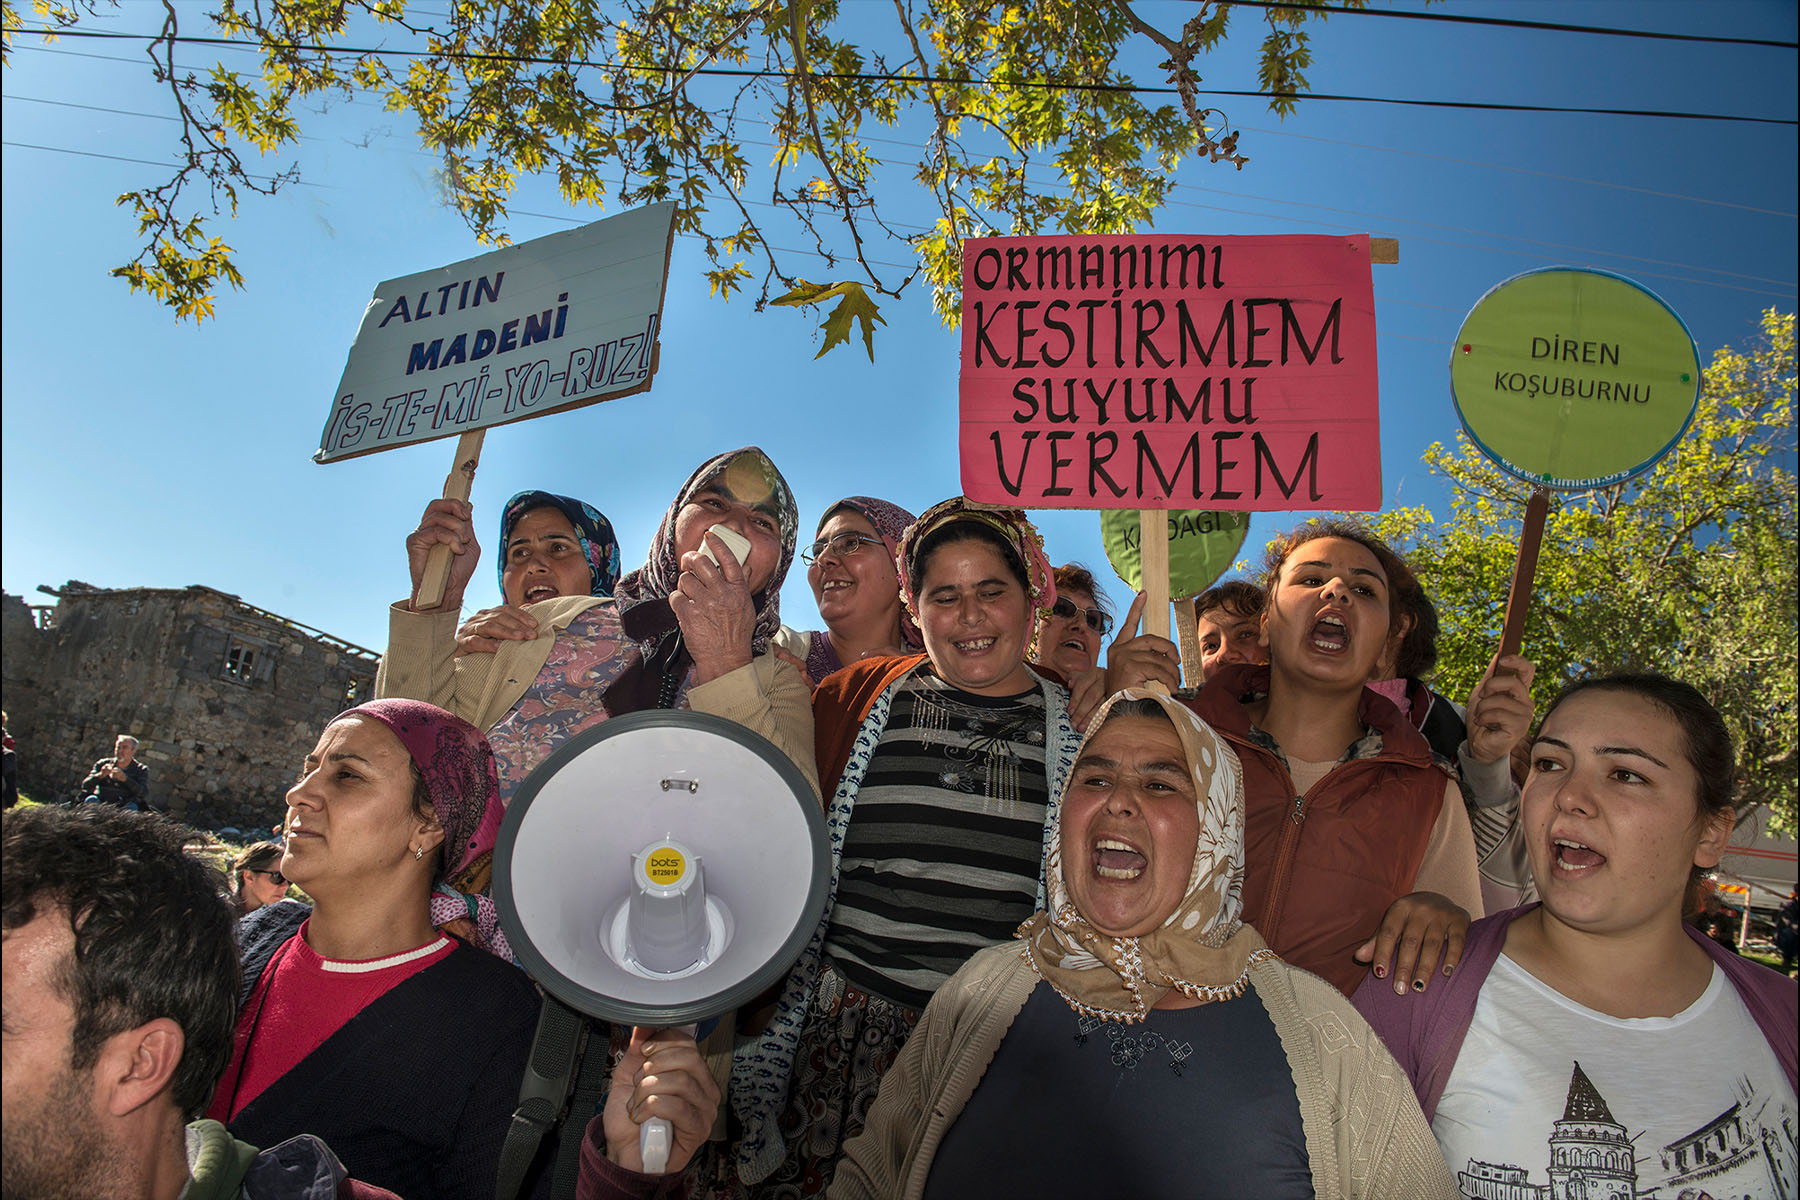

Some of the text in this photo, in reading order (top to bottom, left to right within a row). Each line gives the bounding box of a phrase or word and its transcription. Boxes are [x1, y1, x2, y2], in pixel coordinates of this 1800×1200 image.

[378, 271, 505, 328] ALTIN
[405, 292, 569, 376] MADENİ
[973, 289, 1345, 369] KESTİRMEM
[1531, 333, 1620, 366] DİREN
[1012, 376, 1259, 425] SUYUMU
[1494, 371, 1651, 404] KOŞUBURNU
[989, 430, 1324, 501] VERMEM
[651, 858, 680, 867] bots
